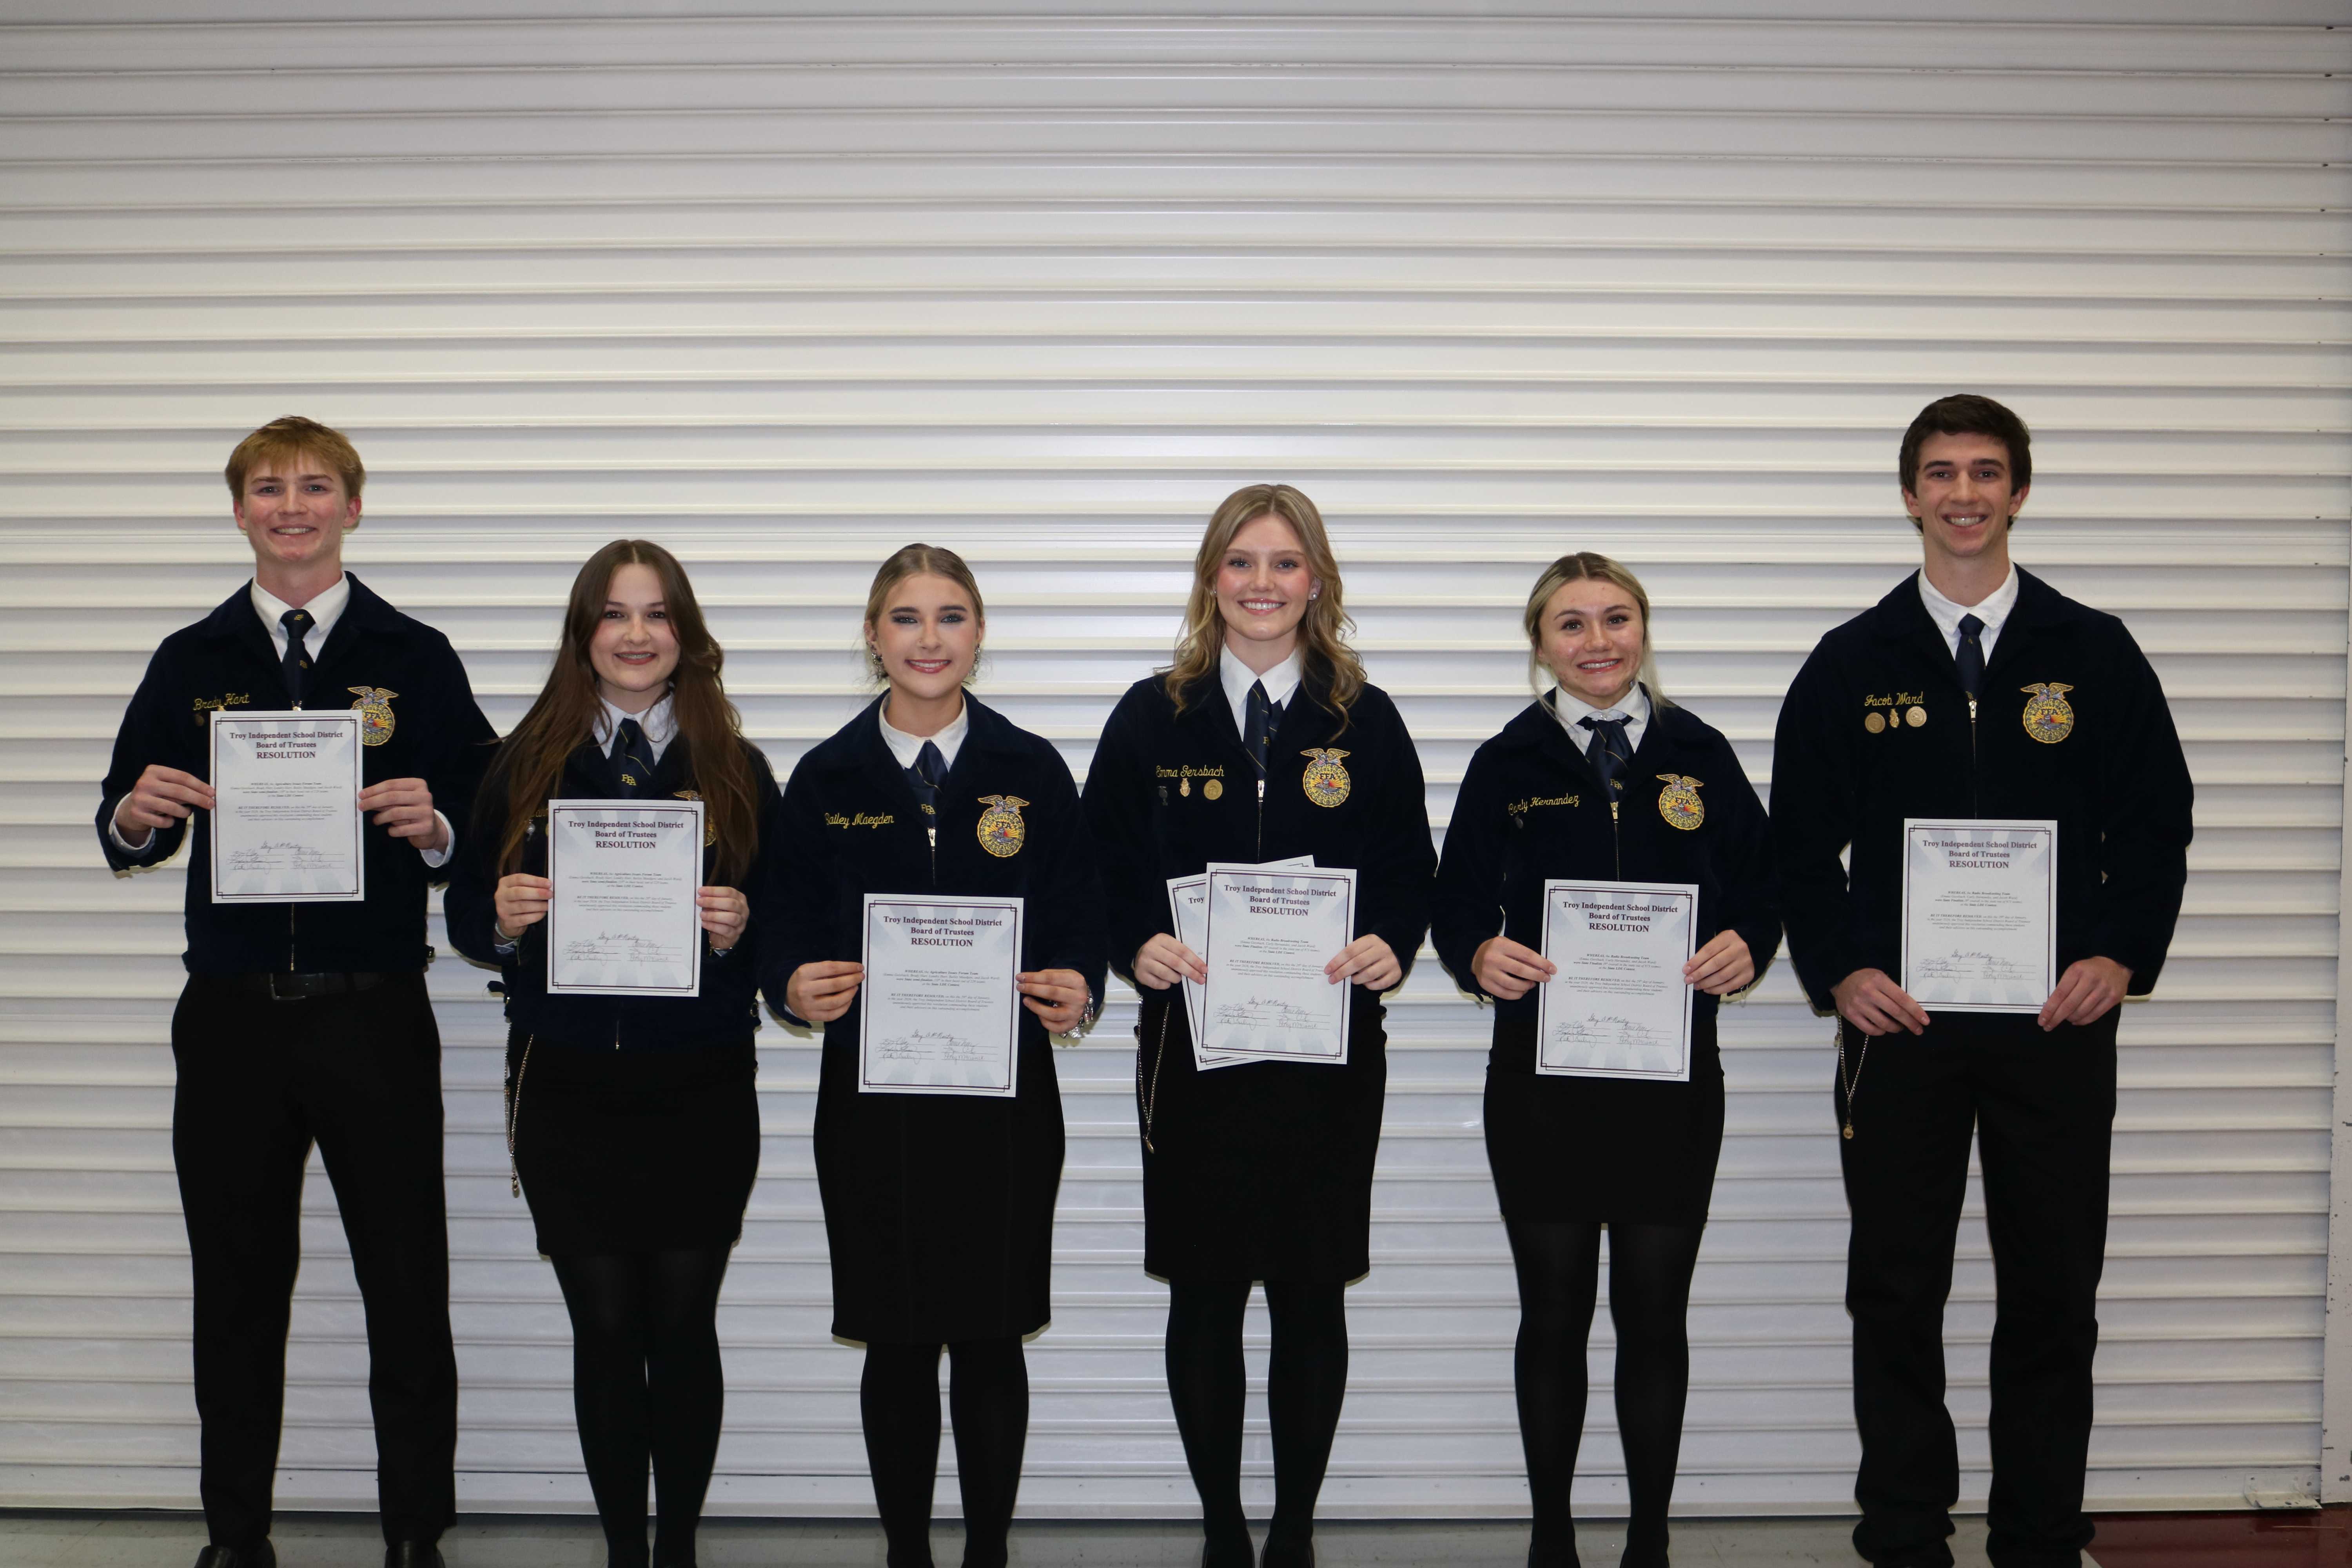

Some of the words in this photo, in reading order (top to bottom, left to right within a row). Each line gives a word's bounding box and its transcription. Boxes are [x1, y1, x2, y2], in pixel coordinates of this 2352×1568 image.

[193, 696, 221, 711] Brady
[224, 693, 250, 706] Hart
[1865, 693, 1893, 706] Jacob
[1895, 691, 1924, 705] Ward
[1156, 766, 1178, 777] Emma
[1180, 765, 1224, 777] Gersbach
[621, 774, 637, 786] FFA
[1610, 779, 1623, 790] FFA
[921, 804, 936, 815] FFA
[1508, 799, 1528, 815] Carly
[1530, 793, 1580, 807] Hernandez
[1250, 906, 1308, 915] RESOLUTION
[1589, 923, 1649, 932] RESOLUTION
[911, 938, 972, 946] RESOLUTION
